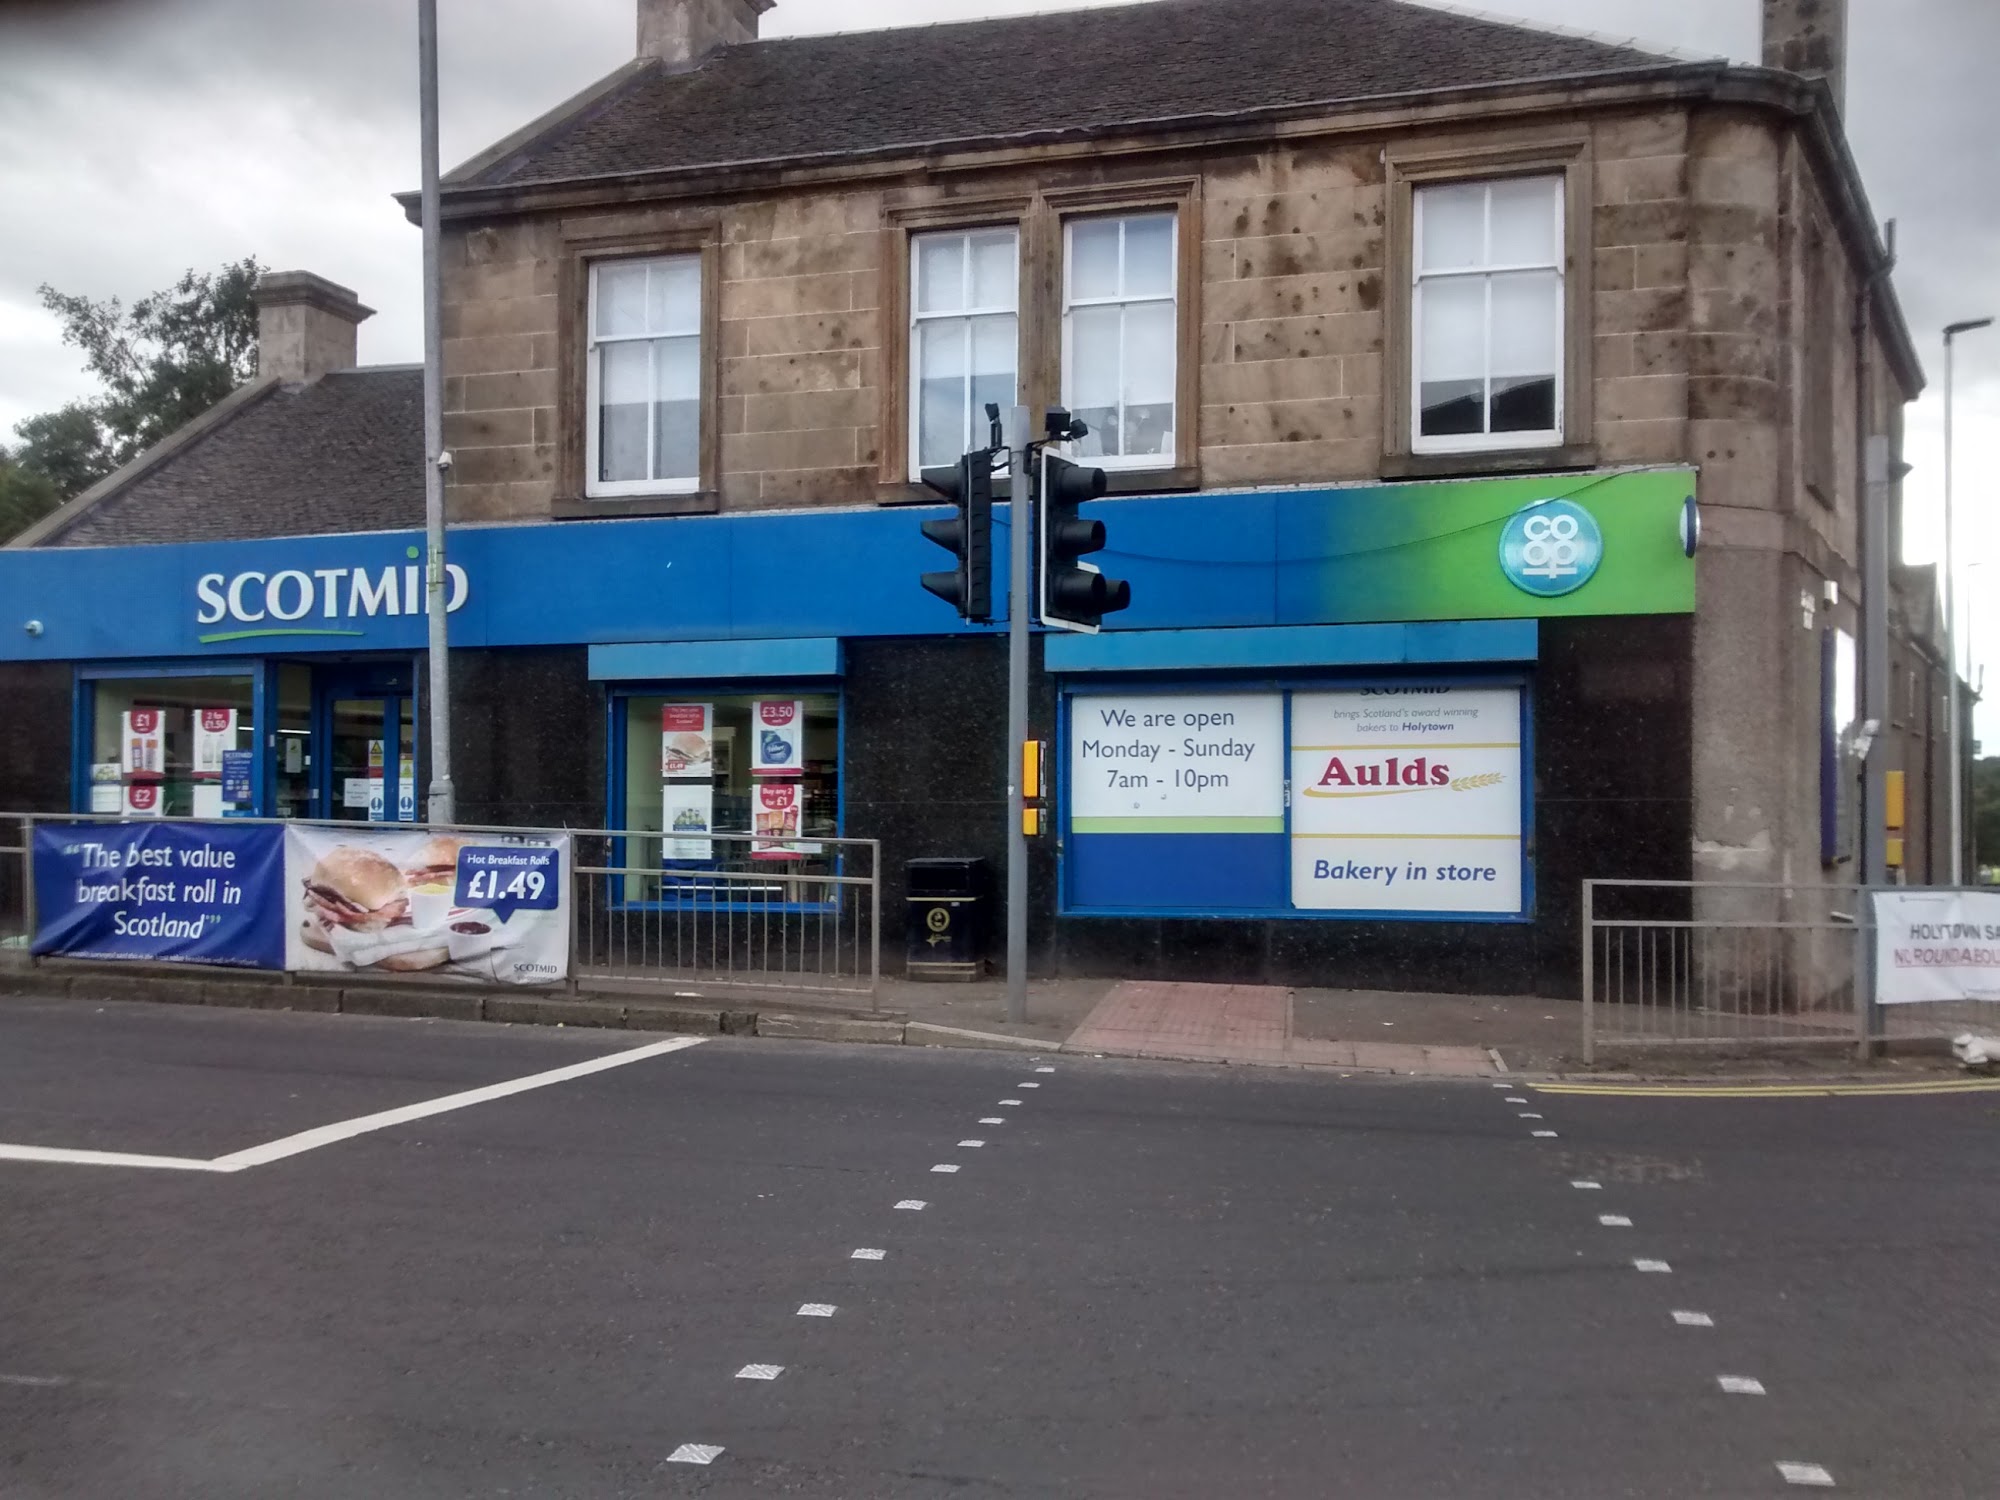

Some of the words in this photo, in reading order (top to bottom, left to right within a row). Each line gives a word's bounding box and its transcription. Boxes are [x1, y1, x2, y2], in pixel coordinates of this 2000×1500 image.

[207, 711, 213, 720] 2
[762, 706, 793, 718] £3.50
[1363, 708, 1409, 718] Scotland's
[1411, 707, 1441, 718] award
[1443, 708, 1479, 718] winning
[136, 713, 150, 726] £1
[1100, 709, 1137, 727] We
[1143, 713, 1175, 727] are
[1183, 712, 1234, 731] open
[1356, 723, 1387, 733] bakers
[1389, 724, 1399, 732] to
[1402, 722, 1454, 733] Holytown
[1082, 739, 1160, 762] Monday
[1183, 738, 1255, 761] Sunday
[1318, 756, 1450, 786] Aulds
[1106, 770, 1149, 789] 7am
[1175, 769, 1230, 791] 10pm
[135, 789, 151, 802] £2
[762, 787, 774, 796] Buy
[776, 798, 788, 806] £1
[126, 842, 172, 868] best
[179, 843, 236, 869] value
[466, 853, 486, 864] Hot
[487, 854, 528, 865] Breakfast
[529, 855, 550, 866] Rolls
[1313, 859, 1398, 886] Bakery
[1405, 861, 1427, 881] in
[1436, 863, 1497, 882] store
[77, 875, 176, 906] breakfast
[183, 878, 216, 904] roll
[222, 880, 241, 904] in
[467, 869, 546, 900] £1.49
[1910, 923, 1981, 941] HOLYTOWN
[513, 963, 558, 974] SCOTMID
